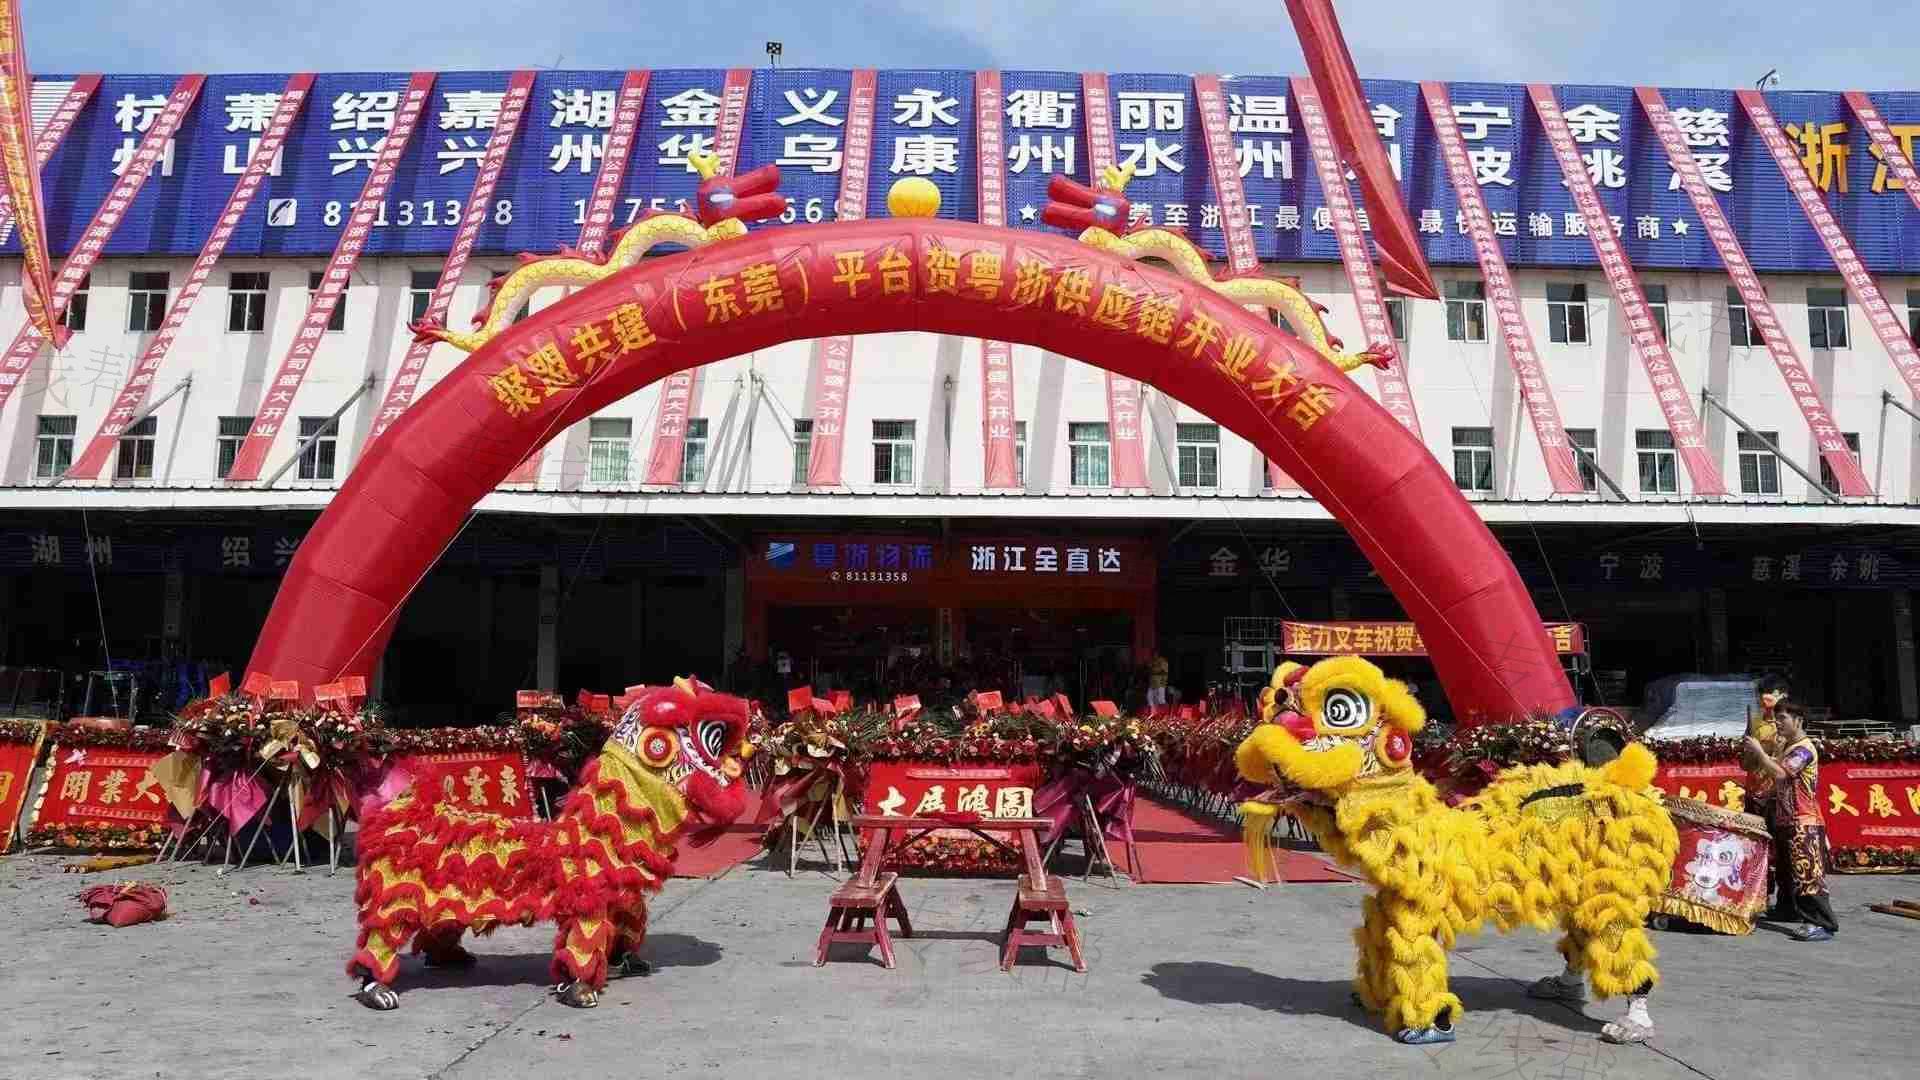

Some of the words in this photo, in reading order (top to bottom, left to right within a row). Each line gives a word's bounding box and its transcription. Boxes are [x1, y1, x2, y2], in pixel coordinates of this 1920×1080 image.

[549, 89, 616, 173] 湖州
[776, 88, 845, 173] 义乌
[889, 88, 960, 175] 永康
[1006, 90, 1076, 175] 衢州
[1118, 92, 1185, 178] 丽水
[1227, 95, 1292, 180] 温州
[846, 571, 909, 582] 81131358
[971, 545, 1121, 573] 浙江全直达
